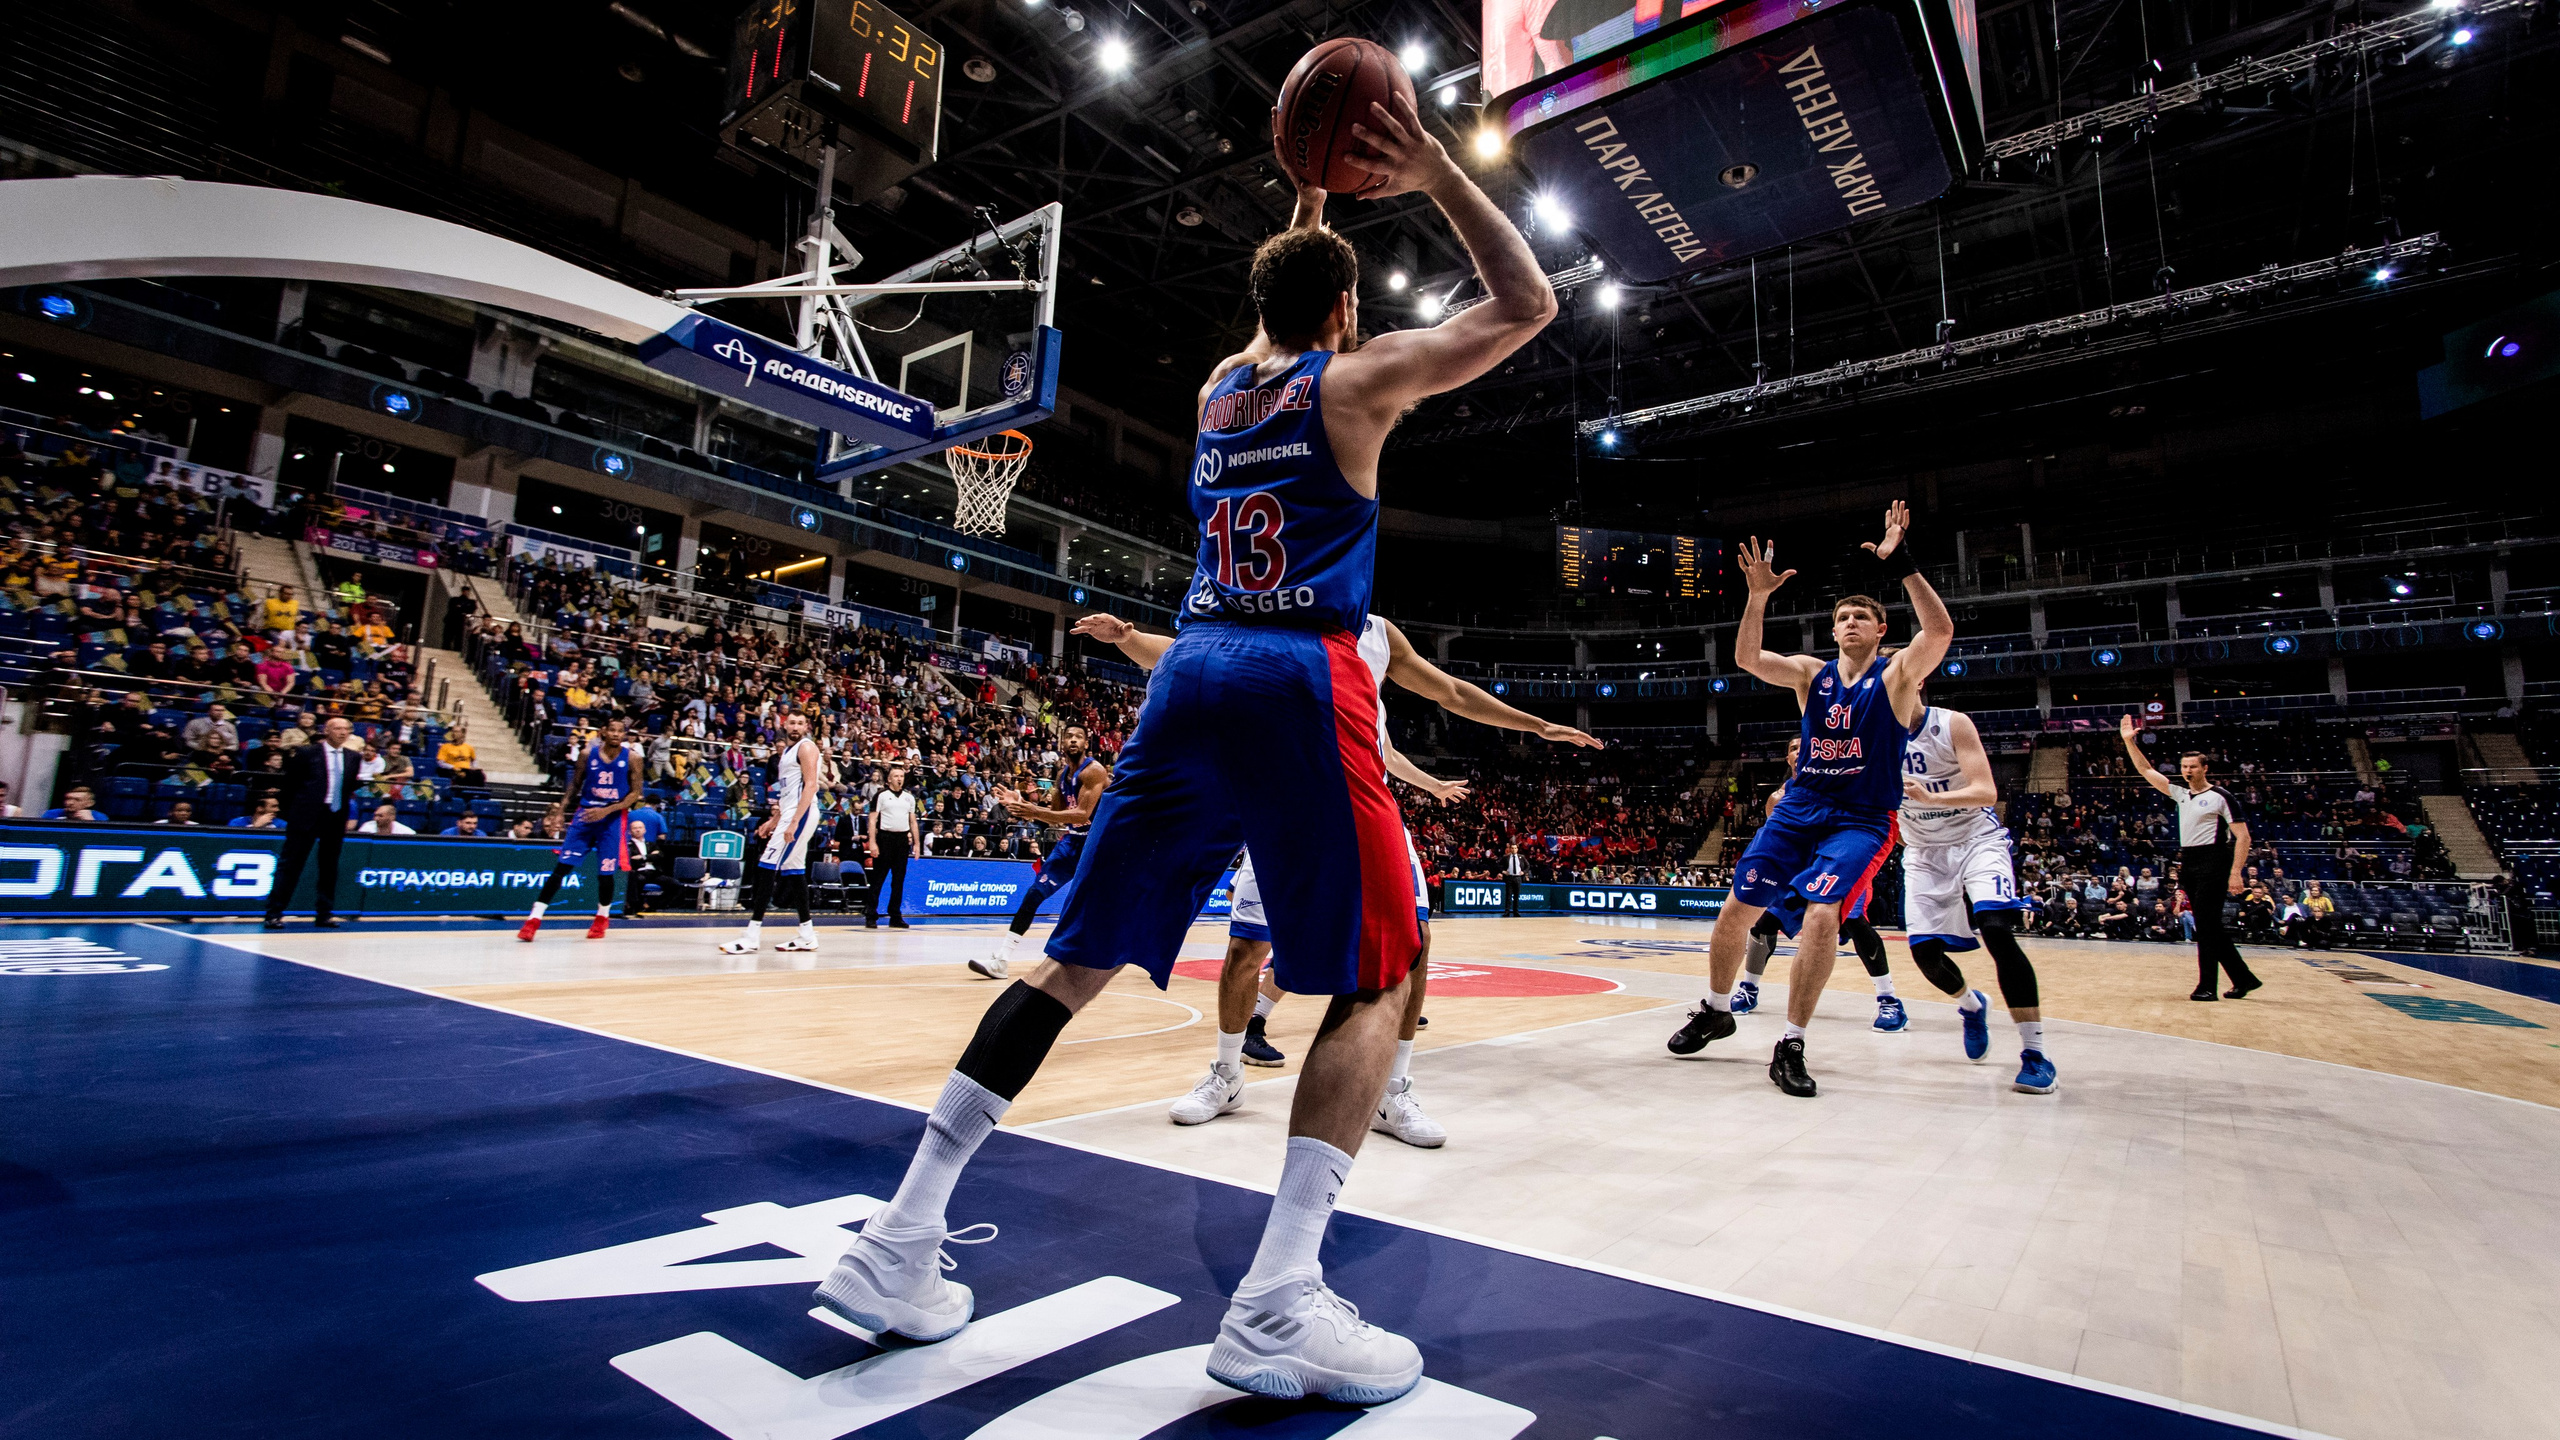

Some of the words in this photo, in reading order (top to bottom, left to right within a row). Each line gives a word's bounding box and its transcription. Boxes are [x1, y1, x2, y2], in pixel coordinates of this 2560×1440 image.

[851, 1, 936, 79] 6:32
[1778, 45, 1859, 155] ЛЕГЕНД
[1575, 116, 1652, 192] ПАРК
[1628, 192, 1706, 264] ЛЕГЕНД
[1826, 153, 1886, 217] ПАРК
[344, 434, 402, 464] 307
[1228, 442, 1312, 468] NORNICKEL
[601, 500, 643, 523] 308
[1207, 491, 1286, 591] 13
[900, 577, 929, 596] 310
[1009, 607, 1032, 624] 311
[1825, 704, 1852, 729] 31
[1811, 737, 1862, 760] CSKA
[1904, 752, 1927, 774] 13
[598, 771, 613, 785] 21
[601, 858, 616, 871] 21
[767, 847, 777, 860] 7
[360, 869, 494, 888] СТРАХОВАЯ
[928, 880, 979, 894] Титульный
[980, 883, 1018, 895] спонсор
[1806, 872, 1839, 896] 31
[1992, 874, 2012, 900] 13
[926, 895, 963, 907] Единой
[964, 895, 987, 906] Лиги
[988, 895, 1008, 906] ВТБ
[1455, 887, 1501, 905] СОГАЗ
[1569, 890, 1657, 910] СОГАЗ
[1327, 1192, 1336, 1205] 13
